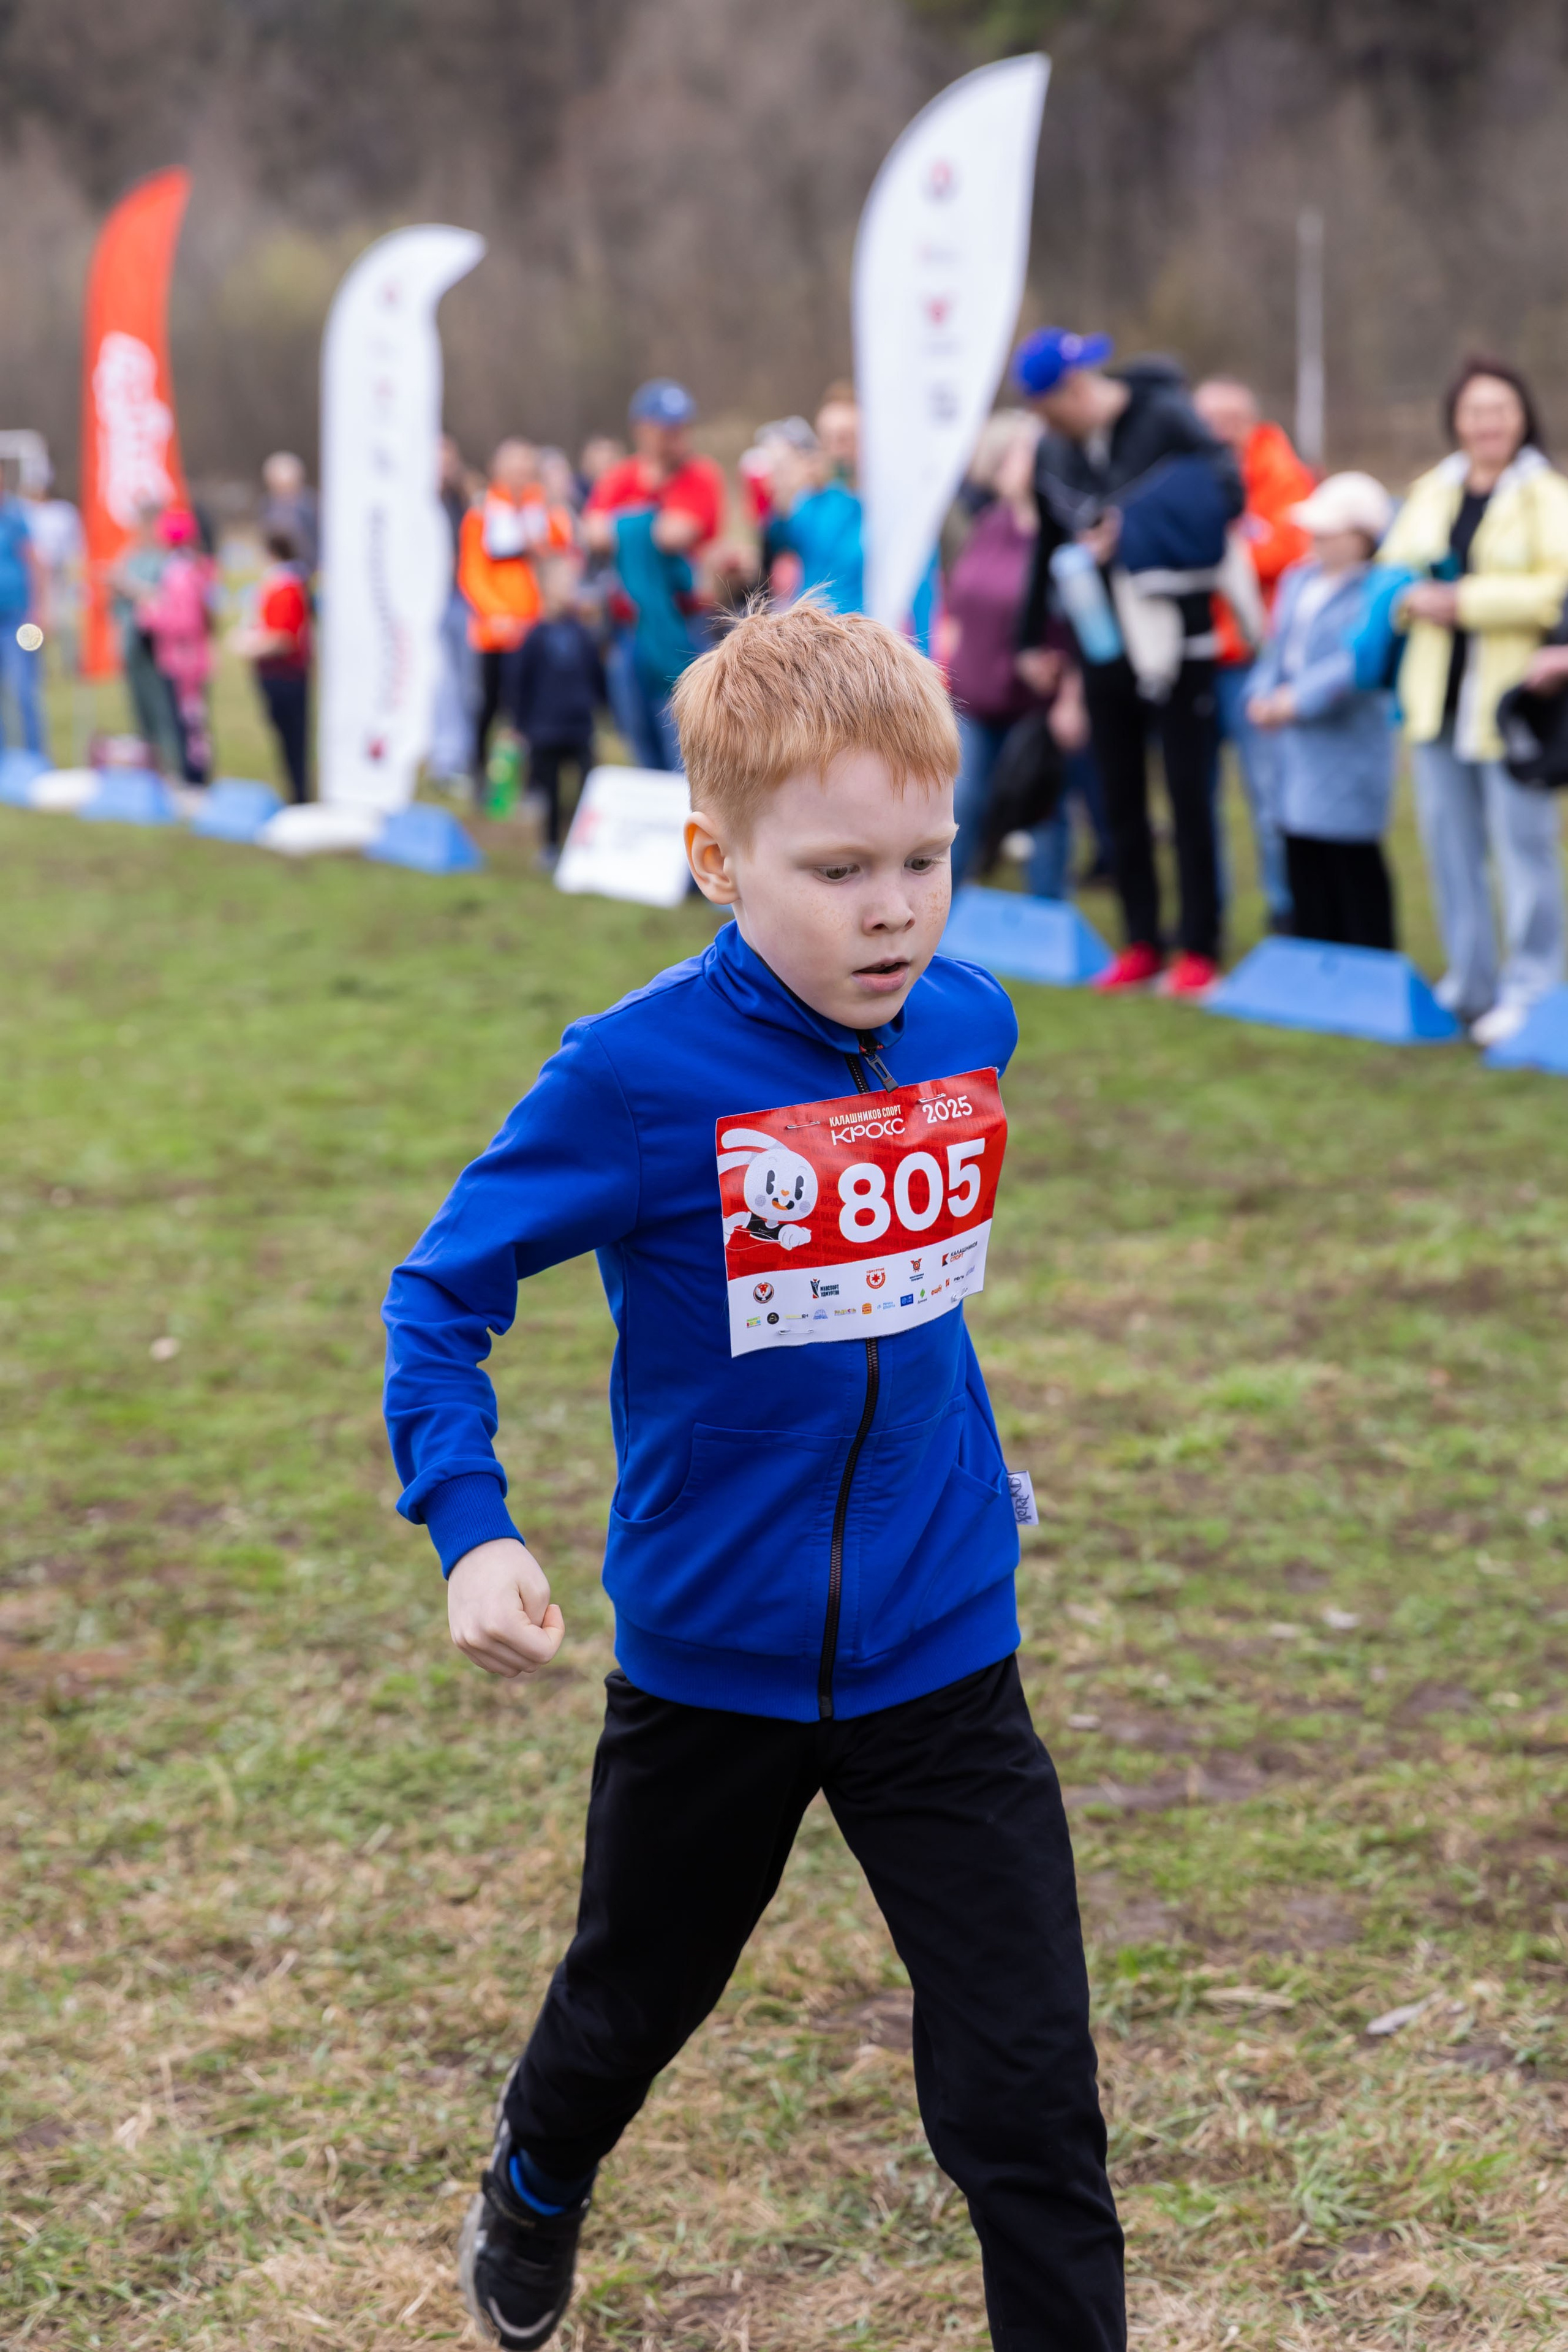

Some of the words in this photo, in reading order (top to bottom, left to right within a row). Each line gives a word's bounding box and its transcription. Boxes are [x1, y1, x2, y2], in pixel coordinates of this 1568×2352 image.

[829, 1108, 882, 1127] КАЛАШНИКОВ
[882, 1105, 902, 1118] СПОРТ
[922, 1095, 973, 1123] 2025
[831, 1118, 906, 1145] КРОСС
[837, 1137, 986, 1243] 805
[949, 1253, 964, 1262] СПОРТ
[950, 1241, 978, 1257] КАЛАШНИКОВ
